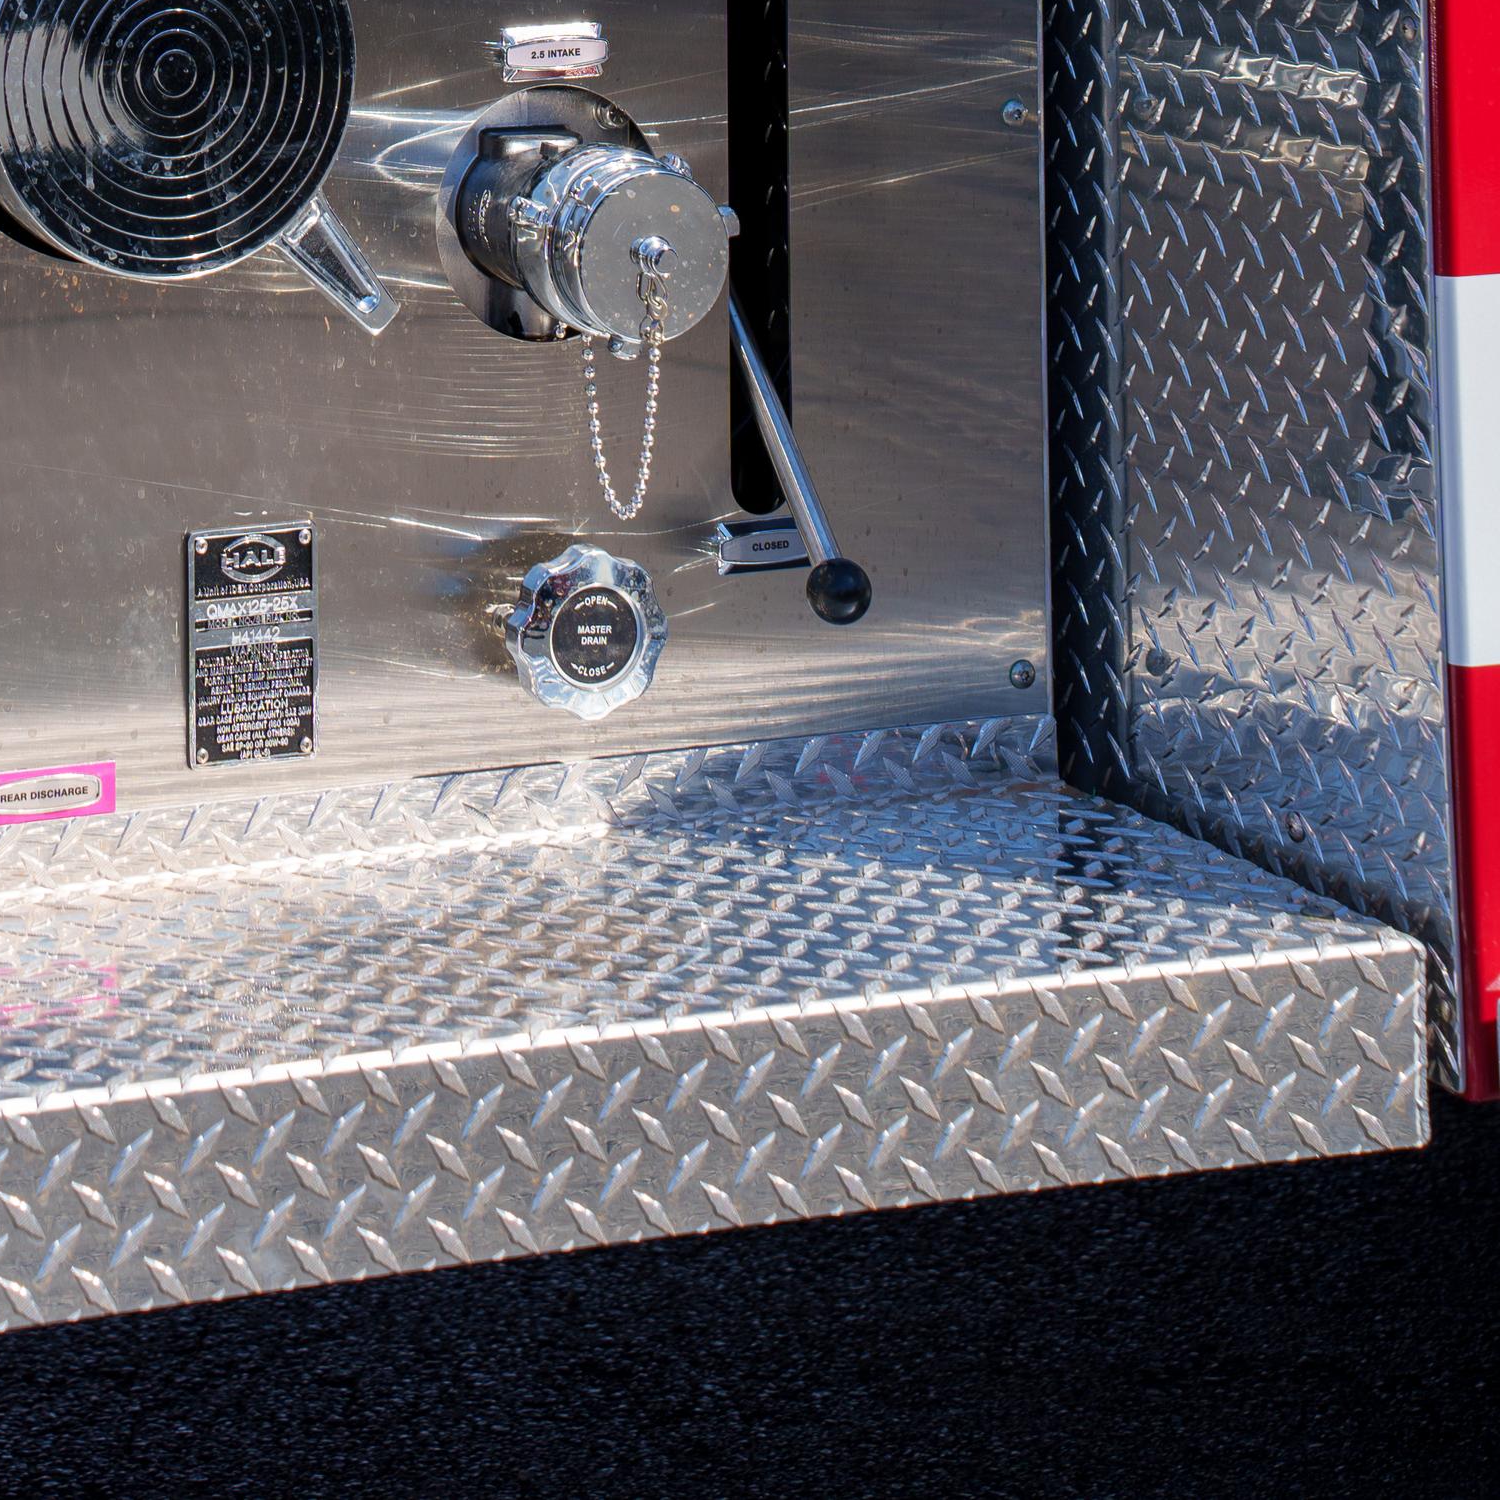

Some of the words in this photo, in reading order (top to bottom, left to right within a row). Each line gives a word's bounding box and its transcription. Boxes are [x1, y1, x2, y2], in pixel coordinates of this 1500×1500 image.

[532, 51, 545, 59] 2.5
[548, 48, 581, 58] INTAKE
[752, 540, 789, 552] CLOSED
[221, 547, 286, 570] HALE
[585, 596, 608, 606] OPEN
[578, 625, 612, 635] MASTER
[581, 636, 607, 645] DRAIN
[230, 642, 278, 657] WARNING
[577, 666, 607, 677] CLOSE
[221, 699, 288, 715] LUBRICATION
[0, 792, 27, 803] REAR
[31, 786, 89, 800] DISCHARGE
